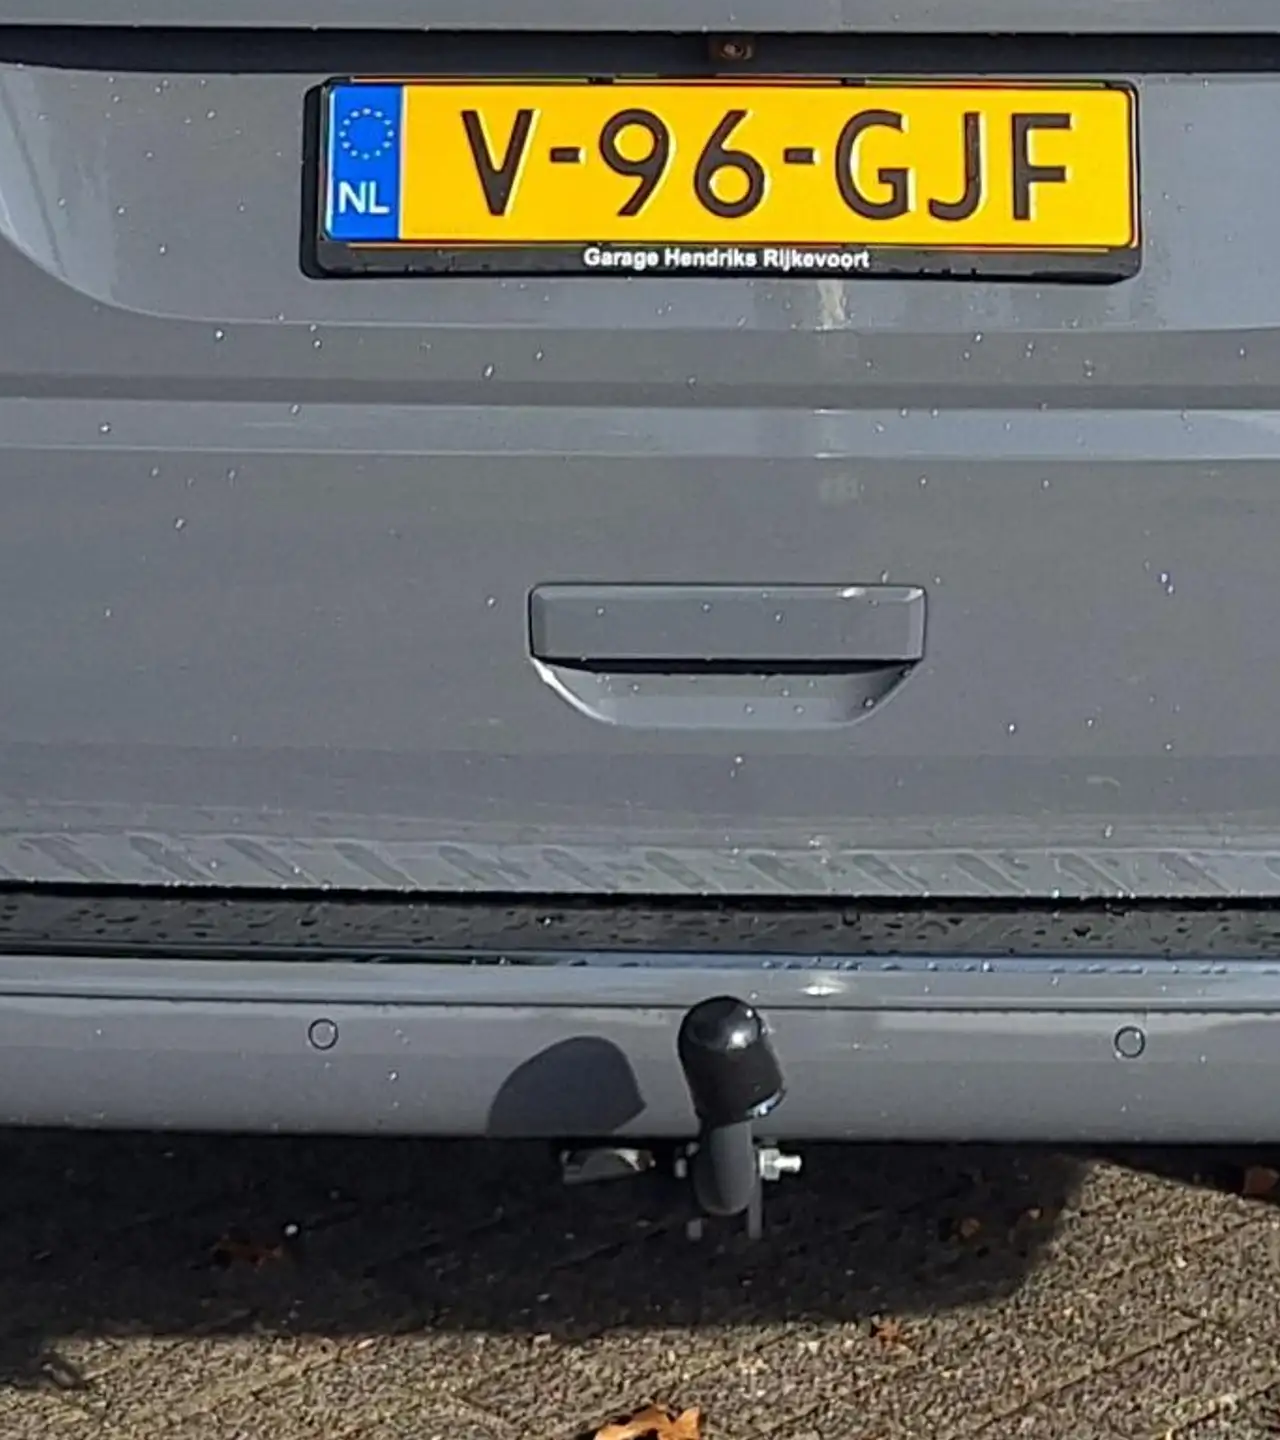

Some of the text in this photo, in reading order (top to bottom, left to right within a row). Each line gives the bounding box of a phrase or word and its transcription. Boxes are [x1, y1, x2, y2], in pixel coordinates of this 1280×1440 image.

[460, 108, 1072, 222] V-96-GJF
[338, 180, 390, 214] NL
[583, 247, 870, 271] Garage Hendriks Rijkevoort
